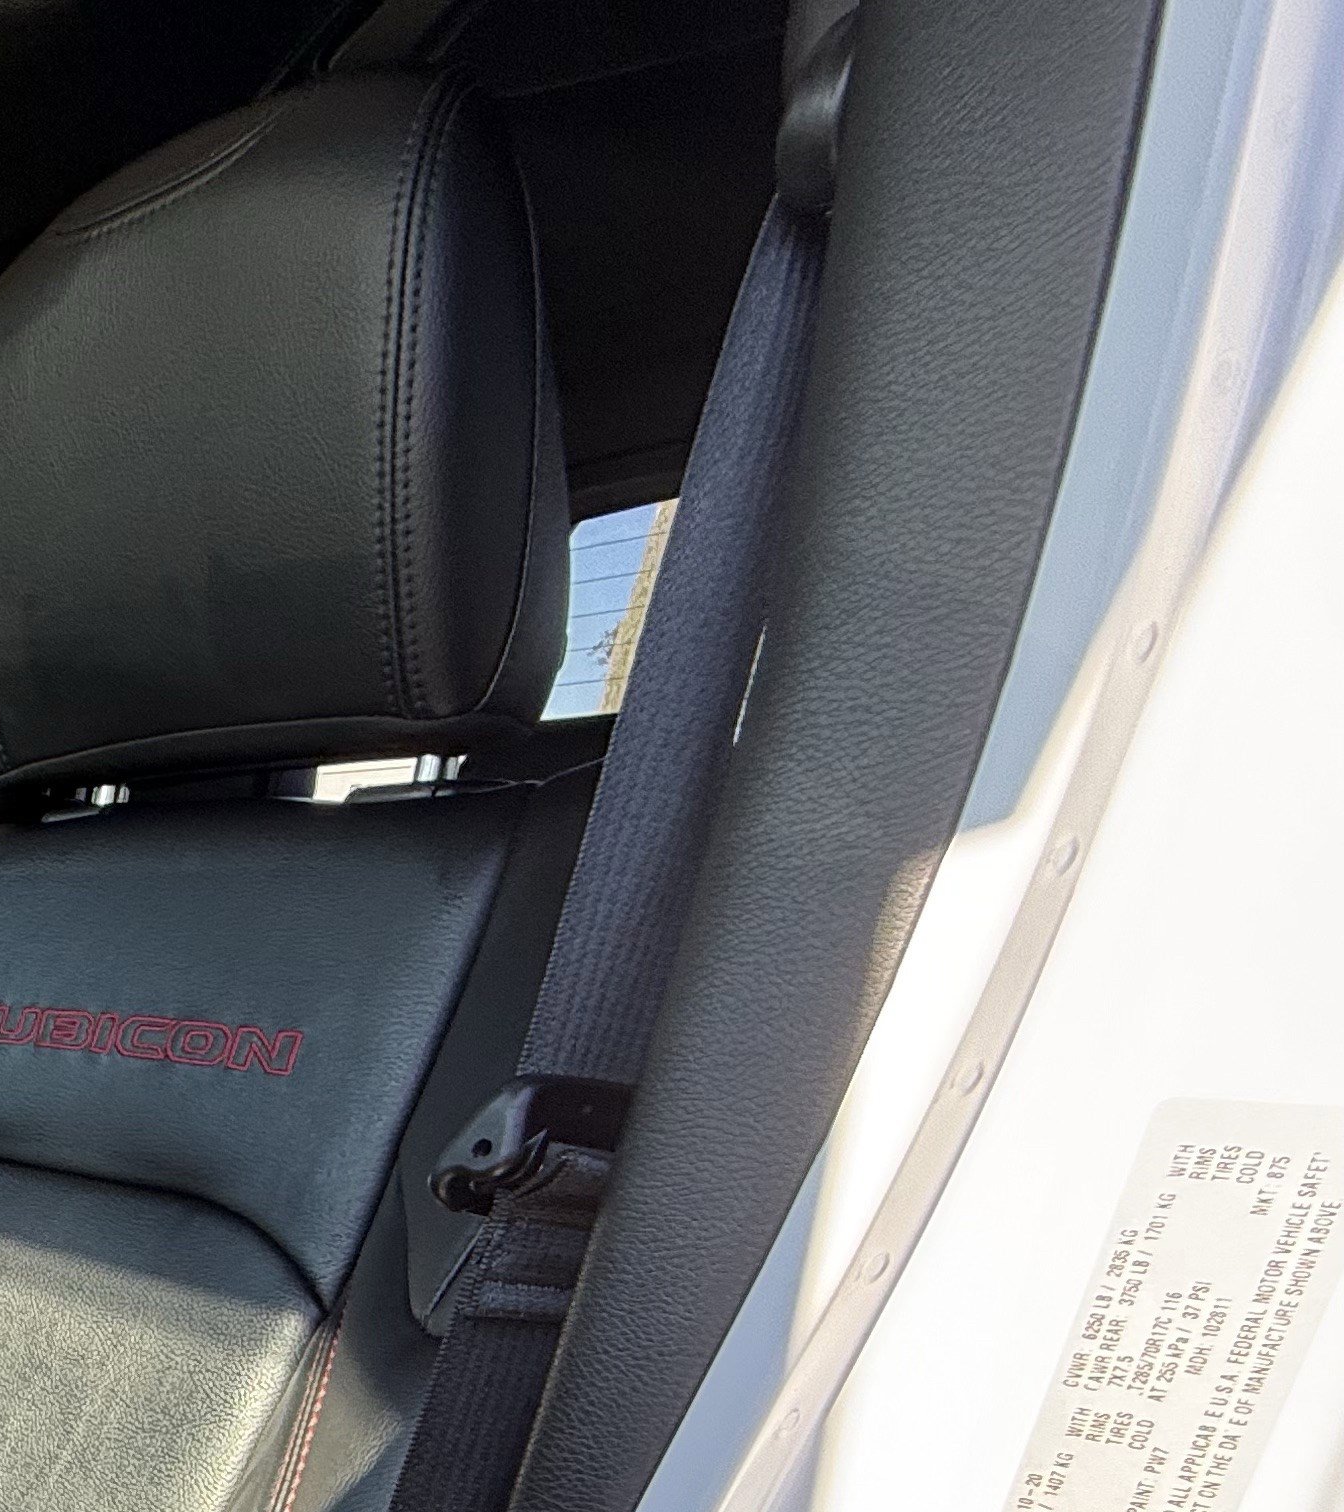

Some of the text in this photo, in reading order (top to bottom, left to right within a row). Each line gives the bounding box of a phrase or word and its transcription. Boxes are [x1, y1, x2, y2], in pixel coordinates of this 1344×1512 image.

[1167, 1142, 1195, 1176] WITH
[1188, 1146, 1216, 1180] RIMS
[1236, 1148, 1265, 1183] COLD
[1266, 1154, 1290, 1178] 875
[1155, 1190, 1176, 1210] KG
[1117, 1226, 1138, 1246] KG
[1143, 1213, 1168, 1239] 1701
[1161, 1290, 1182, 1311] 116
[1211, 1143, 1242, 1181] TIRES
[1272, 1200, 1312, 1256] VEHICLE
[1105, 1247, 1130, 1277] 2835
[1130, 1257, 1149, 1275] LB
[1282, 1245, 1320, 1296] SHOWN
[1118, 1276, 1142, 1306] 3750
[1188, 1279, 1212, 1301] PSI
[1252, 1257, 1288, 1305] MOTOR
[1093, 1293, 1112, 1309] LB
[1181, 1304, 1201, 1320] 37
[1201, 1296, 1232, 1336] 102811
[1082, 1312, 1105, 1339] 6250
[1226, 1305, 1267, 1366] FEDERAL
[1165, 1334, 1188, 1358] kPa
[1241, 1297, 1298, 1394] MANUFACTURE
[1156, 1359, 1178, 1382] 255
[1148, 1384, 1166, 1402] AT
[1232, 1398, 1255, 1414] OF
[1065, 1405, 1091, 1437] WITH
[1085, 1411, 1111, 1442] RIMS
[1105, 1410, 1133, 1446] TIRES
[1127, 1417, 1154, 1449] COLD
[1217, 1417, 1247, 1450] DAE
[1053, 1450, 1074, 1469] KG
[1144, 1445, 1169, 1475] PW7
[1177, 1409, 1223, 1481] APPLICABE
[1205, 1452, 1232, 1479] THE
[1042, 1470, 1065, 1497] 1407
[1166, 1483, 1191, 1506] ALL
[1197, 1479, 1220, 1498] ON
